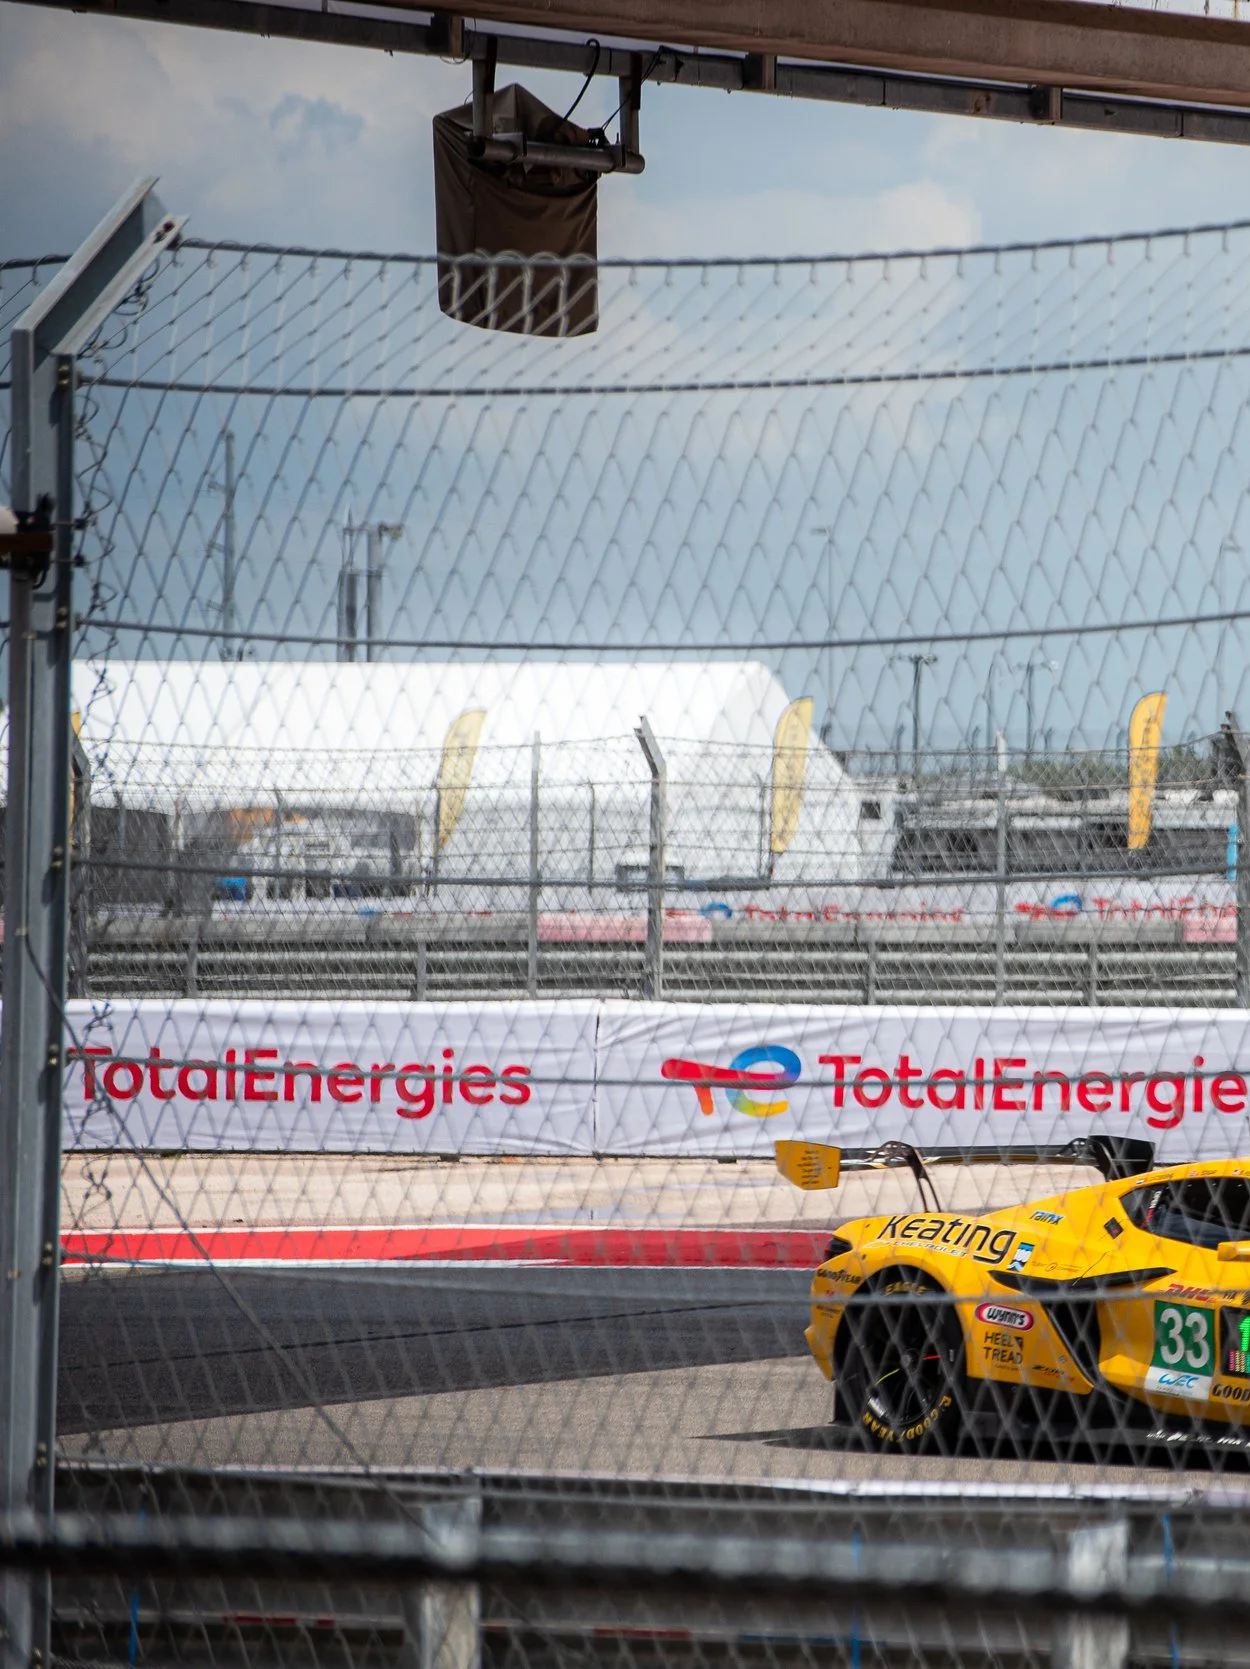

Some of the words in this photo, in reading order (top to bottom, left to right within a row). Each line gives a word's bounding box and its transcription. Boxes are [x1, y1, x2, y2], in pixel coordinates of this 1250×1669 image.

[67, 1047, 531, 1118] TotalEnergies
[877, 1215, 1018, 1264] Keating
[817, 1269, 862, 1284] GOODYEAR
[1166, 1283, 1214, 1303] DHL
[984, 1332, 1014, 1347] HEEL
[1160, 1308, 1210, 1368] 33
[983, 1347, 1023, 1364] TREAD
[1158, 1373, 1199, 1388] WEC
